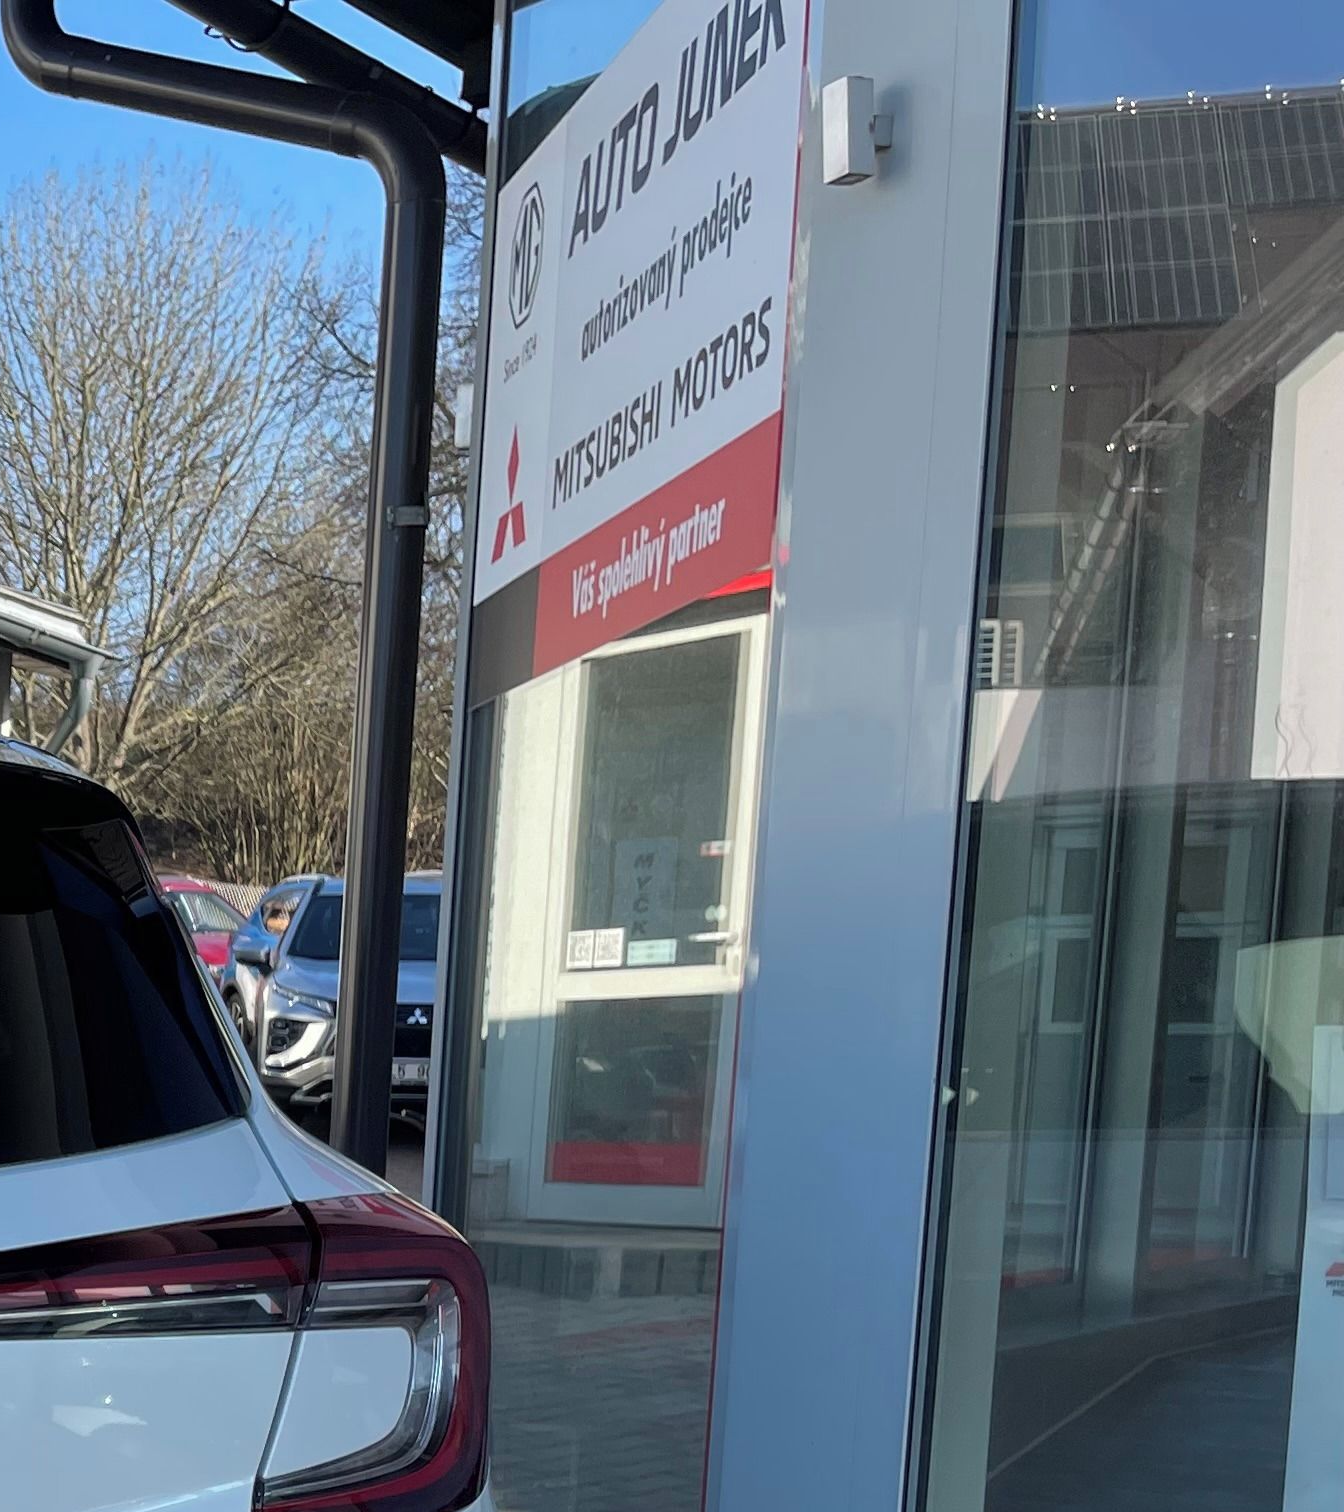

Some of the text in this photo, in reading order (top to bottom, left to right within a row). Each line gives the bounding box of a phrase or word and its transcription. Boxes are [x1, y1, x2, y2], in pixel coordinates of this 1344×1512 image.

[568, 0, 787, 260] AUTO JUNEK
[581, 171, 753, 362] autorizovaný prodejce
[552, 296, 772, 511] MITSUBISHI MOTORS
[571, 498, 726, 620] Váš spolehlivý partner
